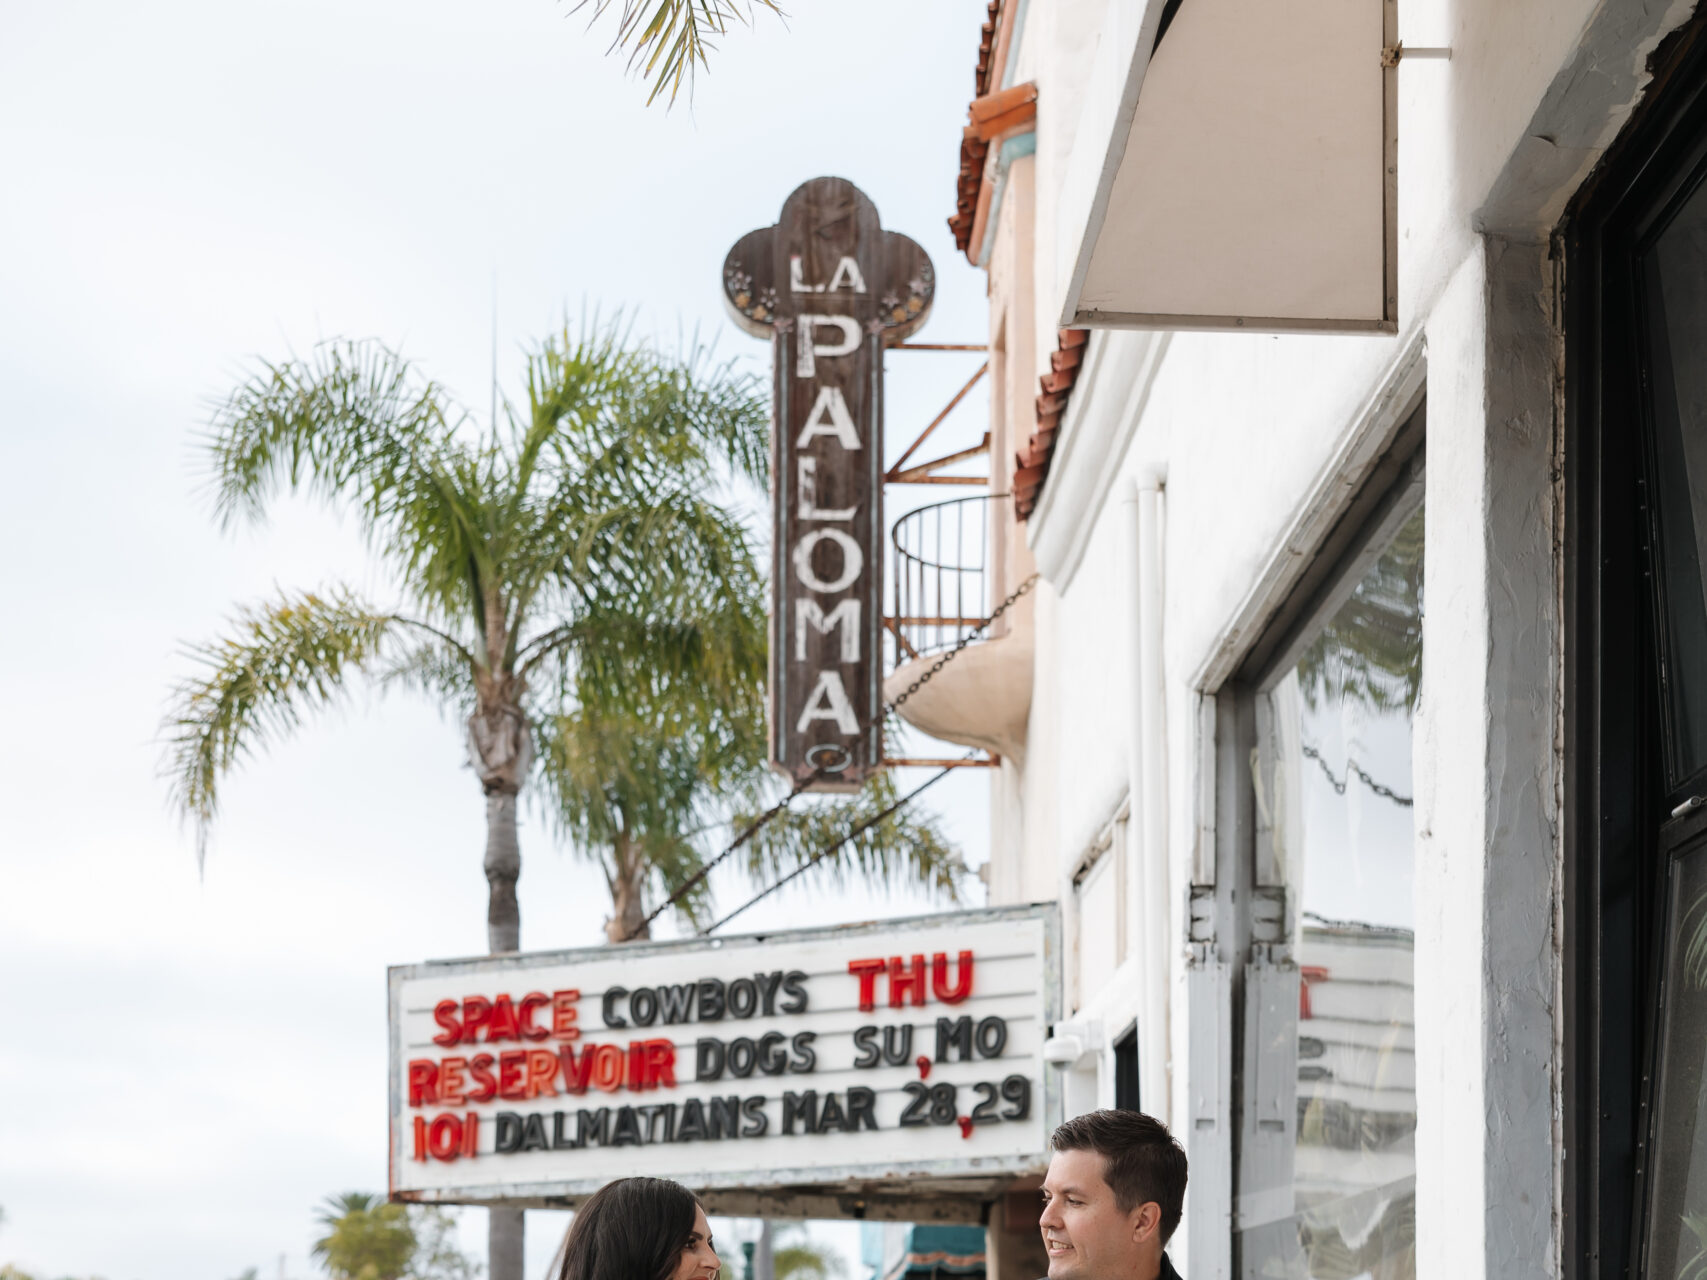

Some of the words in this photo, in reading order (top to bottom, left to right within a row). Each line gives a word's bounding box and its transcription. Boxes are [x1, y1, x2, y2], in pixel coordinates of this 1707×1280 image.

[791, 256, 867, 293] LA
[792, 314, 864, 735] PALOMA
[433, 989, 581, 1047] SPACE
[602, 970, 810, 1028] COWBOYS
[848, 950, 974, 1012] THU
[408, 1038, 676, 1107] RESERVOIR
[696, 1031, 817, 1082] DOGS
[495, 1095, 768, 1154] DALMATIANS
[781, 1086, 878, 1136] MAR
